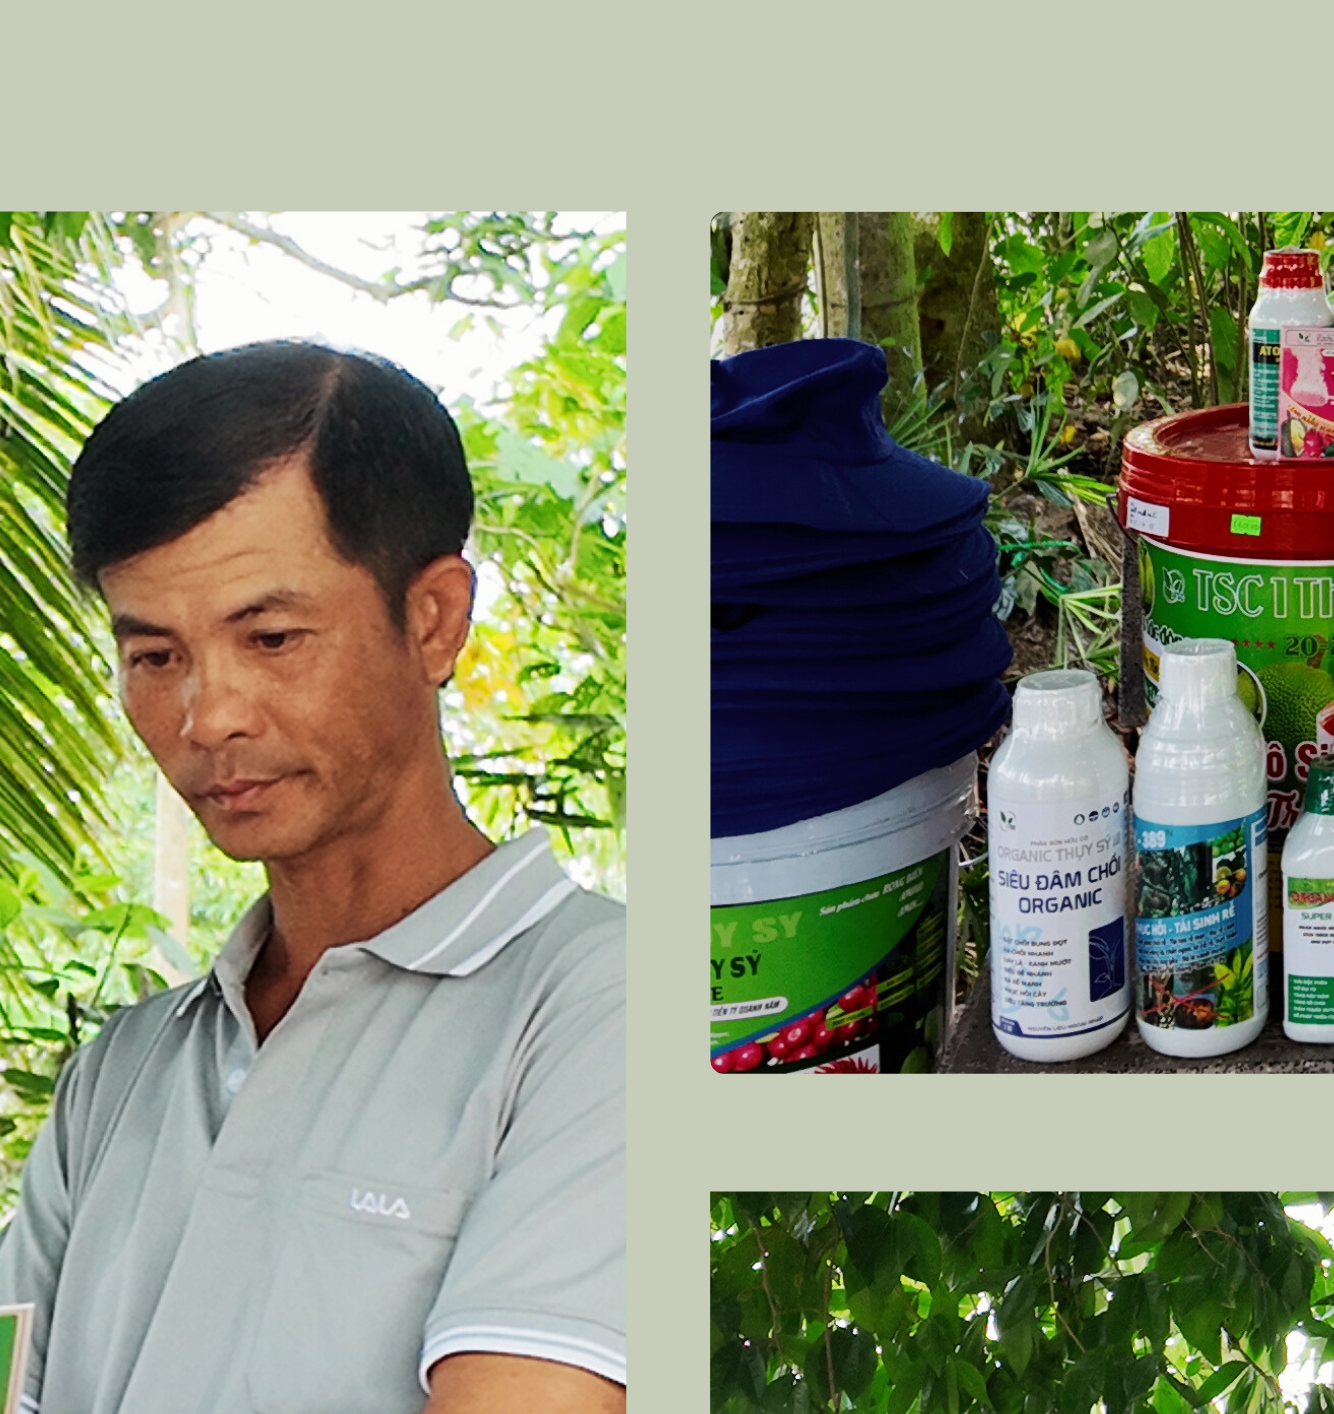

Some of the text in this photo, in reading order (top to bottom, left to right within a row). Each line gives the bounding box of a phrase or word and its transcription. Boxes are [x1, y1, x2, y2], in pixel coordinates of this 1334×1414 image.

[1192, 568, 1265, 618] TSC
[998, 843, 1094, 863] ORGANIC THỤY
[998, 868, 1082, 890] SIÊU ĐÂM
[1019, 888, 1102, 914] ORGANIC
[751, 911, 803, 944] SY
[1301, 912, 1332, 921] SUPER
[351, 1187, 411, 1219] LALA
